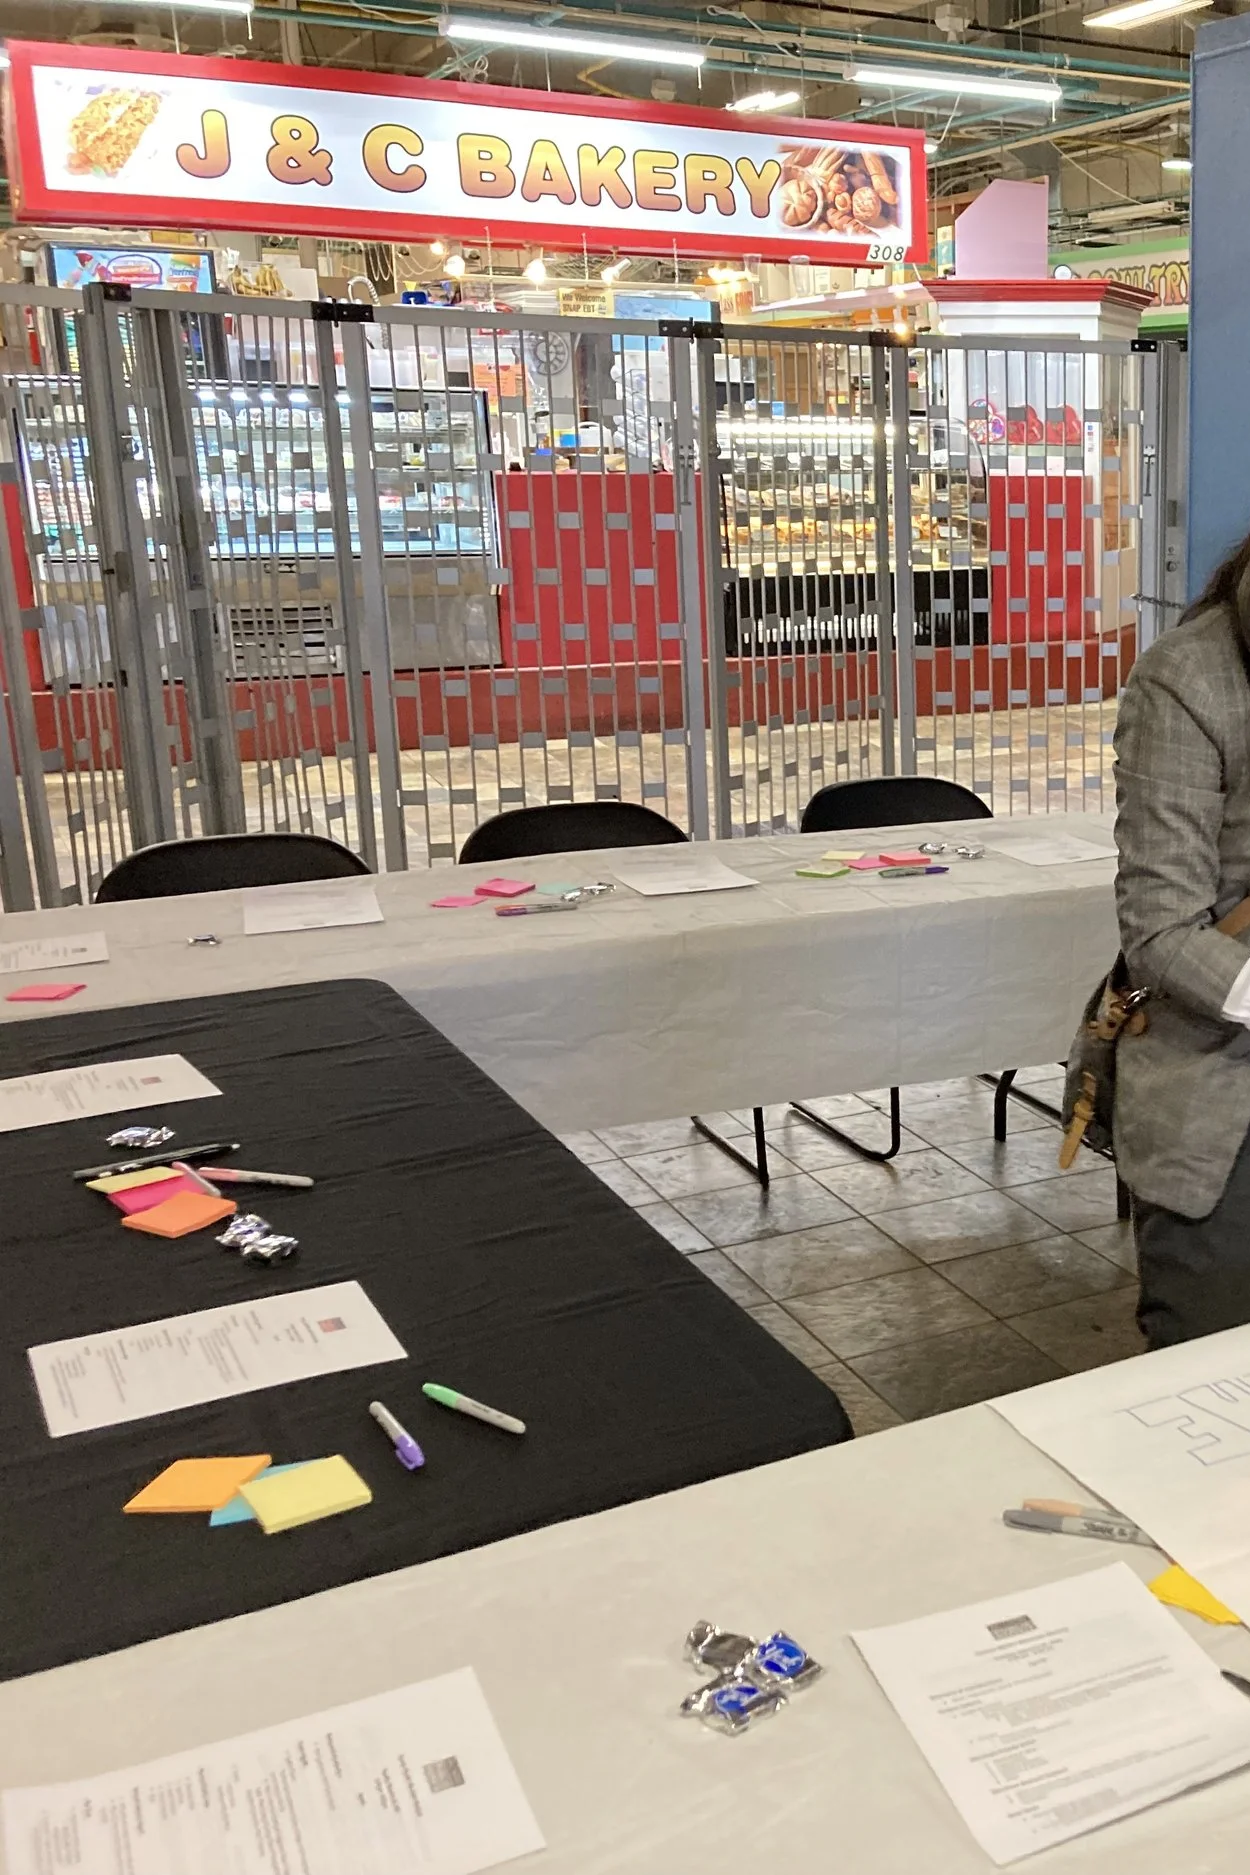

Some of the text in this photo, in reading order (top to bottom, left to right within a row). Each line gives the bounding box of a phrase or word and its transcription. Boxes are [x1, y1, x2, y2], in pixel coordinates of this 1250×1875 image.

[176, 109, 783, 219] J & C BAKERY
[870, 244, 904, 261] 308
